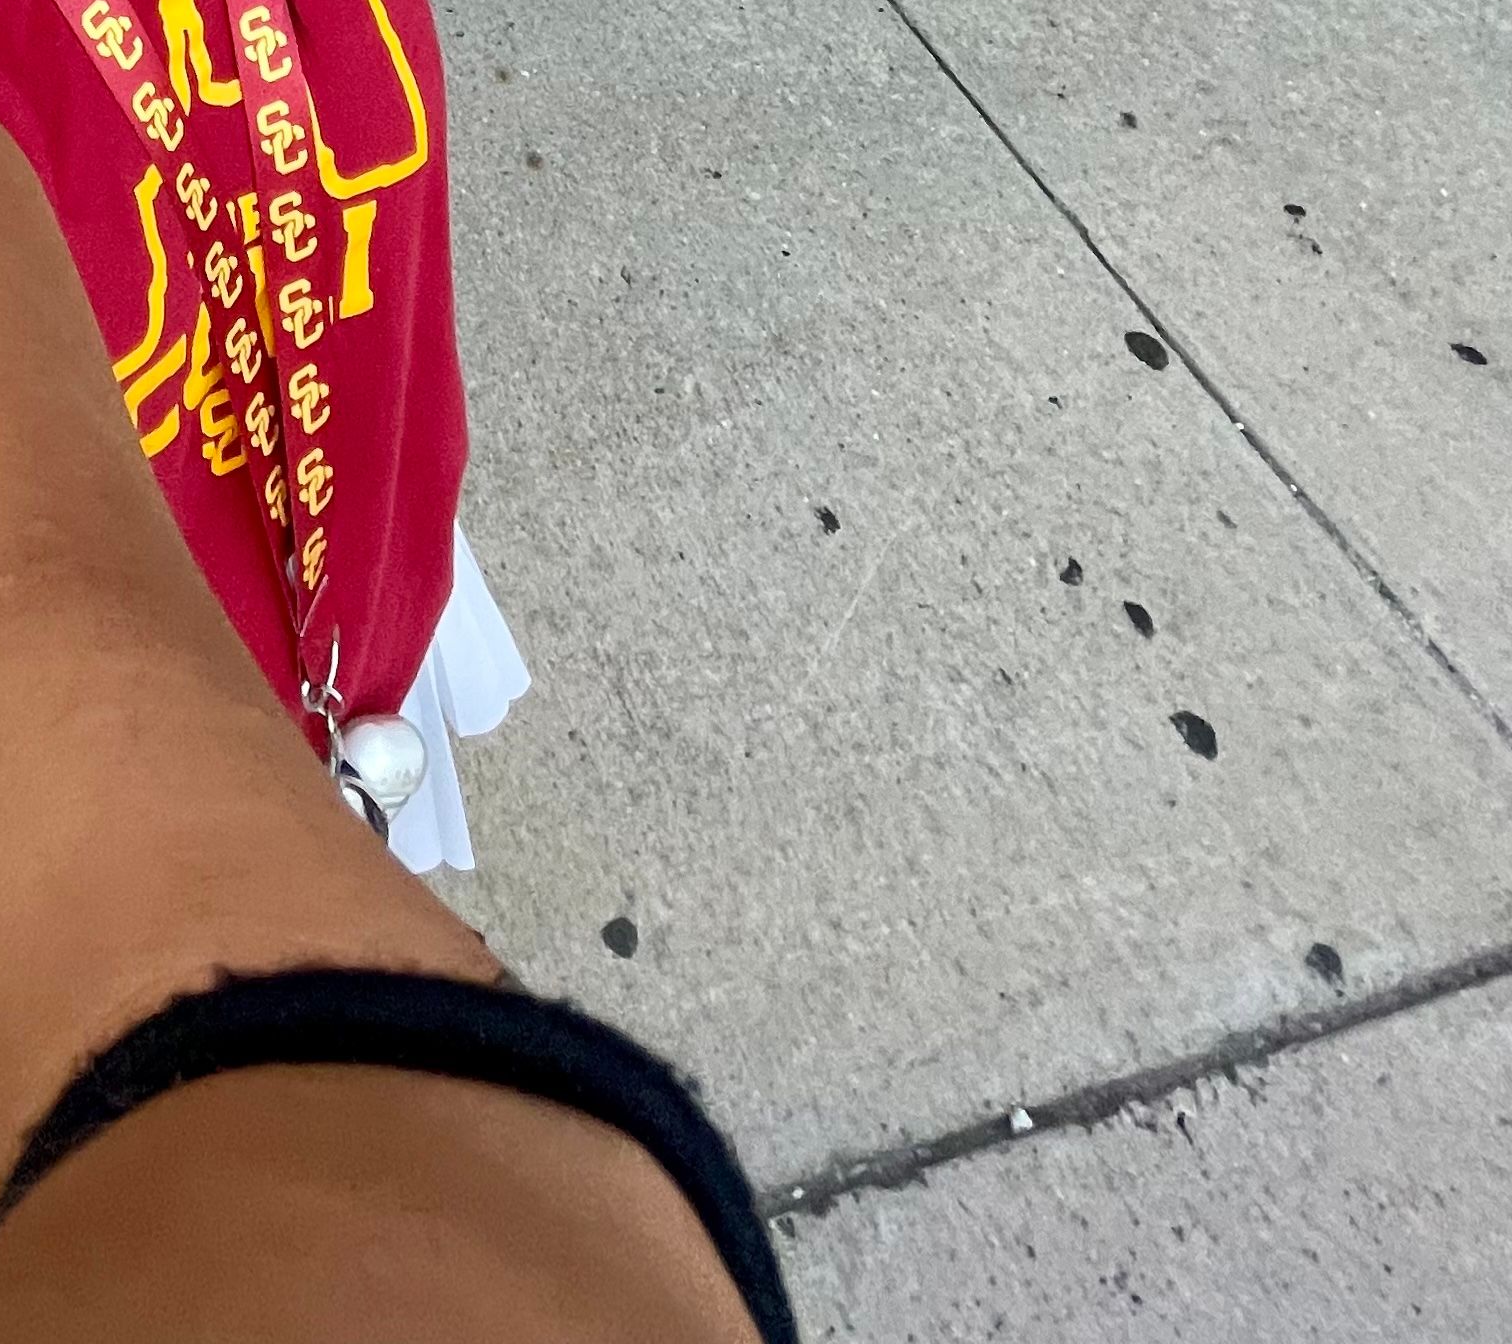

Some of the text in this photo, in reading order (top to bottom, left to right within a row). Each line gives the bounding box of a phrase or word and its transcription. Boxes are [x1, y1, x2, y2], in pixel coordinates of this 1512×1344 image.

[239, 6, 292, 82] SC
[257, 100, 308, 175] SC
[81, 0, 142, 70] SC
[132, 82, 184, 151] SC
[176, 162, 217, 231] SC
[205, 241, 243, 308] SC
[225, 318, 261, 383] SC
[245, 392, 279, 456] SC
[269, 191, 317, 262] SC
[279, 278, 323, 349] SC
[289, 363, 330, 435] SC
[297, 447, 333, 517] SC
